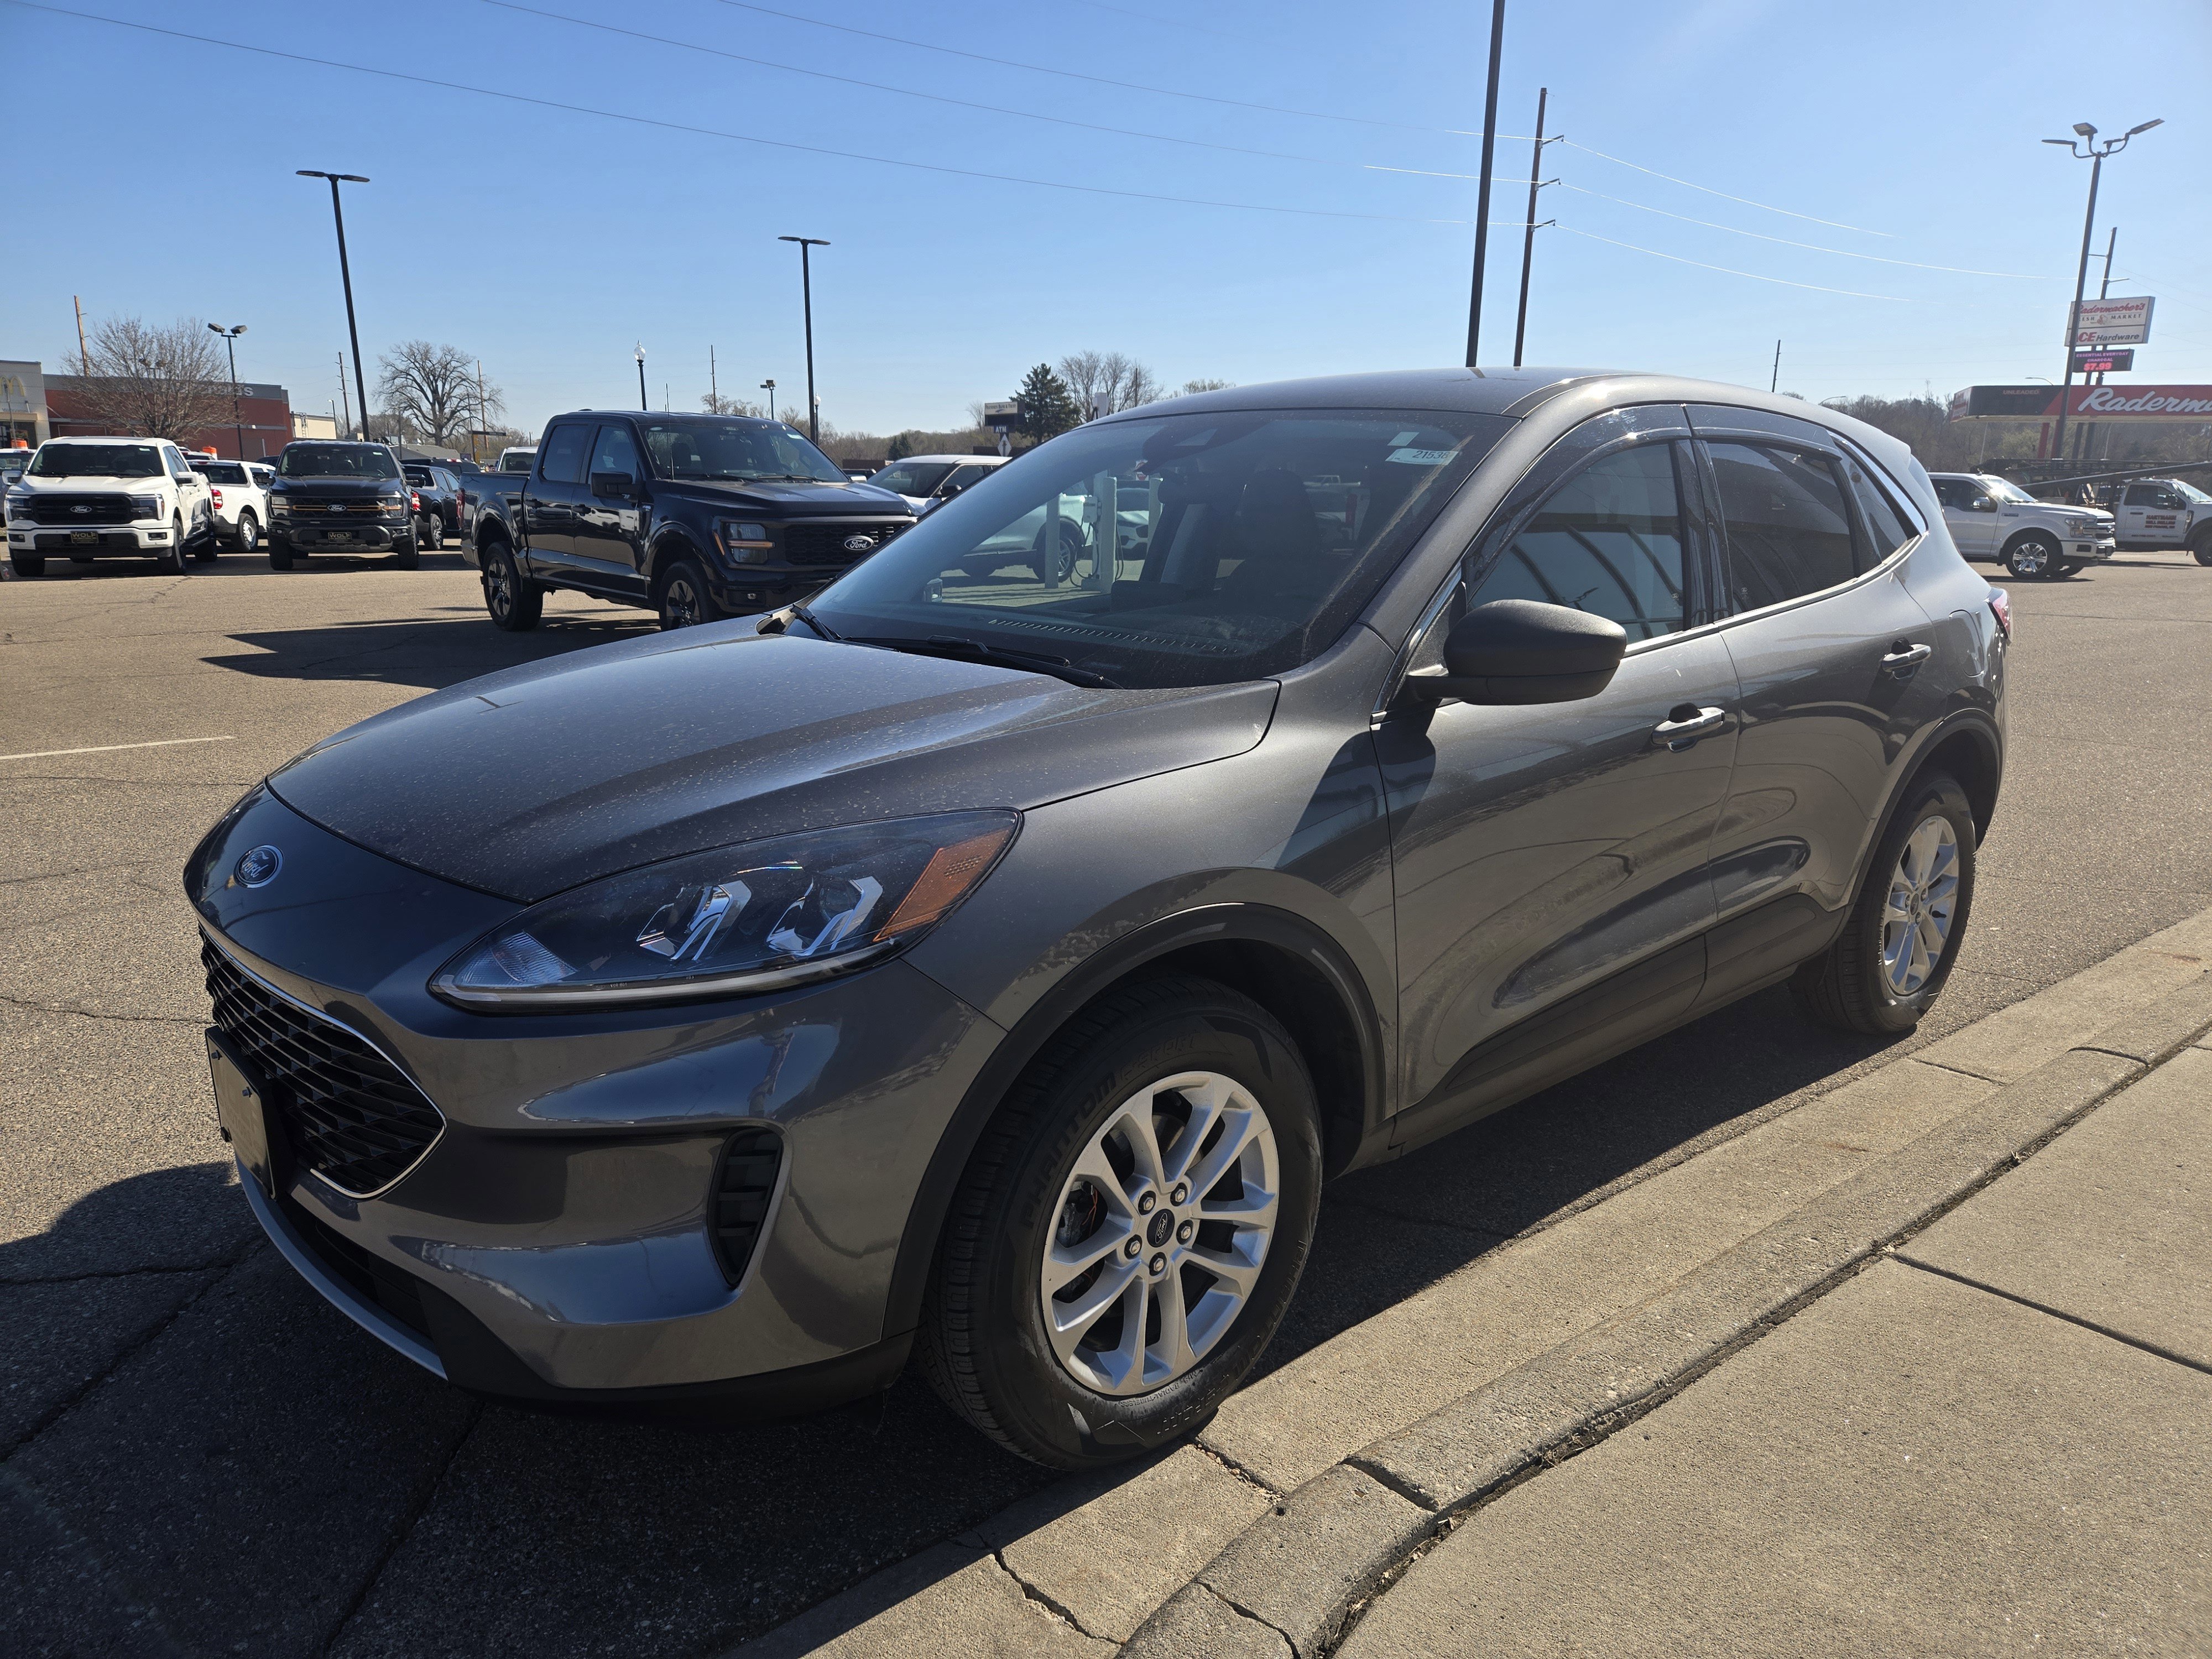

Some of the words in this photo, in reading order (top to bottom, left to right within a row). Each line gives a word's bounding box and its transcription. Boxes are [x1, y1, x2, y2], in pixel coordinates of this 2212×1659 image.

[2077, 331, 2097, 342] CE
[2096, 333, 2140, 342] Hardware
[2083, 362, 2112, 371] $7.99
[850, 540, 868, 548] Ford
[242, 851, 269, 878] Ford
[1157, 1218, 1166, 1238] Ford
